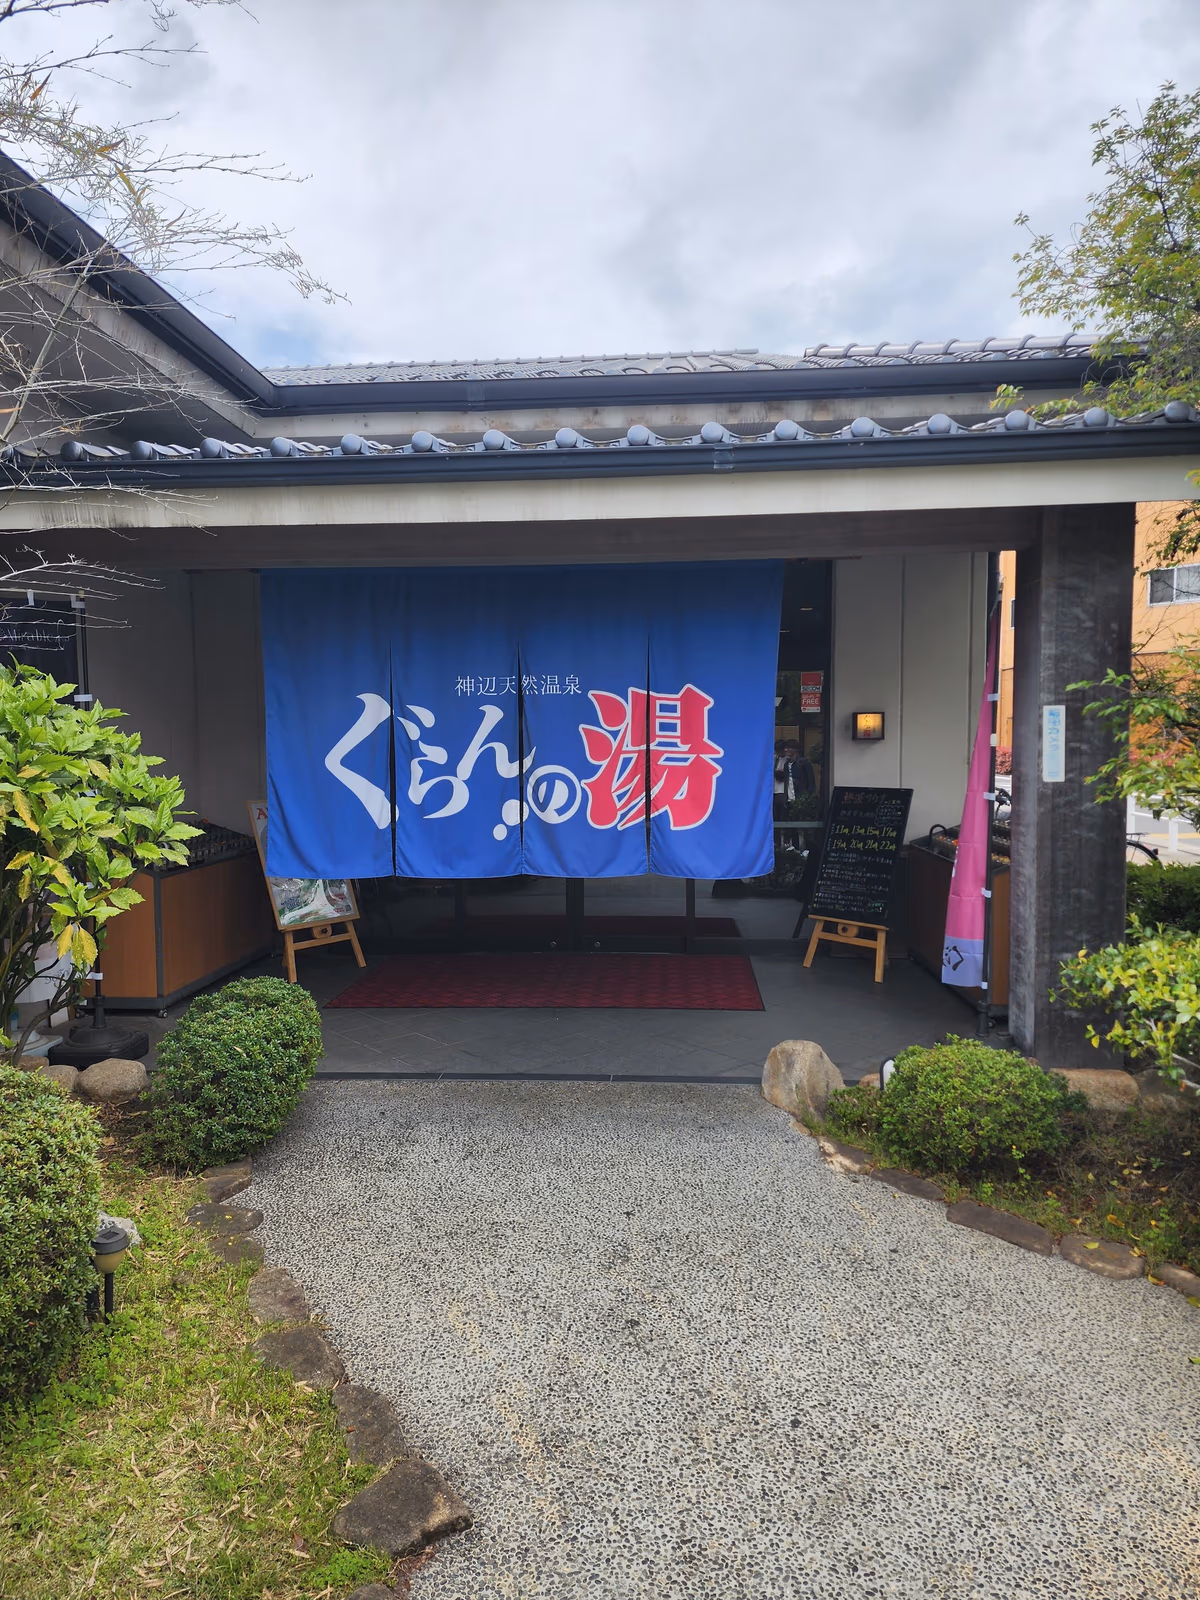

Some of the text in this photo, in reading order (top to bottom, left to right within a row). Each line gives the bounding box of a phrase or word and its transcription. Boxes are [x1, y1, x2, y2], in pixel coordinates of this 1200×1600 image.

[454, 674, 583, 696] 神辺天然温泉
[324, 683, 724, 832] ぐらんの湯
